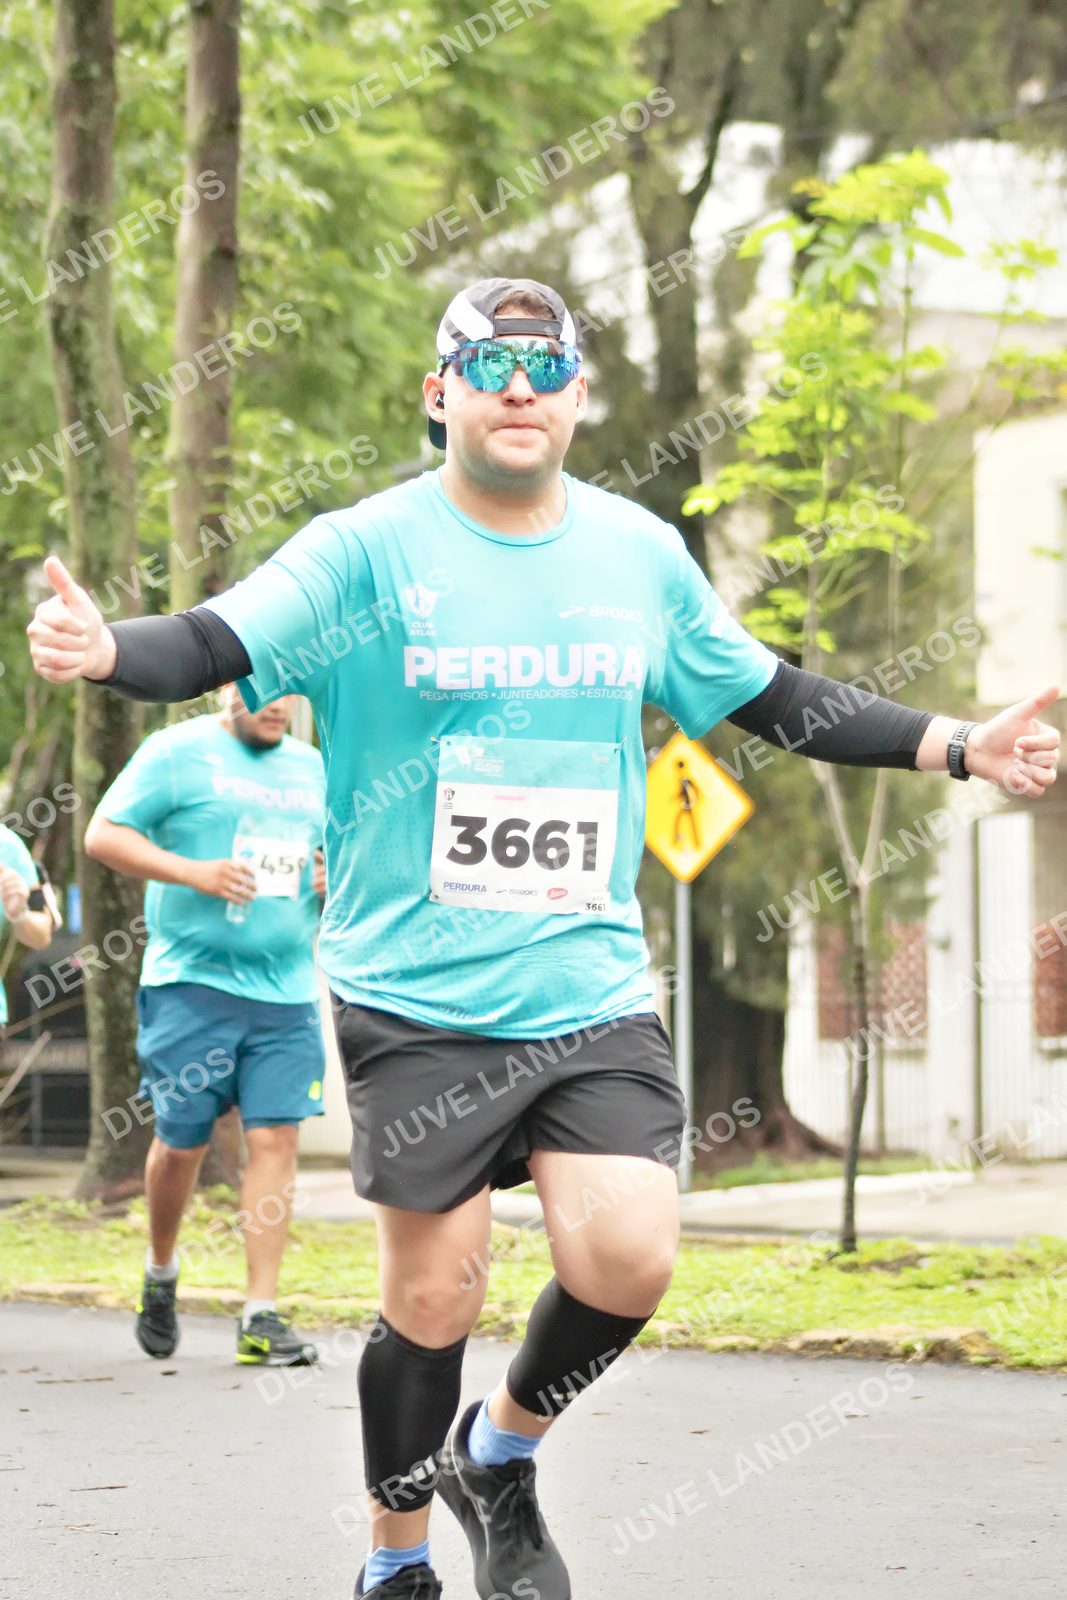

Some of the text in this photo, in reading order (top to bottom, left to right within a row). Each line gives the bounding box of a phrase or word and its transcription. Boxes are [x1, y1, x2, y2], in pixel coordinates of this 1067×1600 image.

[589, 606, 643, 621] BROOKS
[404, 644, 643, 689] PERDURA
[419, 688, 633, 701] PEGA PISOS JUNTEADORES ESTUCOS
[446, 814, 599, 872] 3661
[443, 881, 488, 893] PERDURA
[585, 902, 607, 911] 3661
